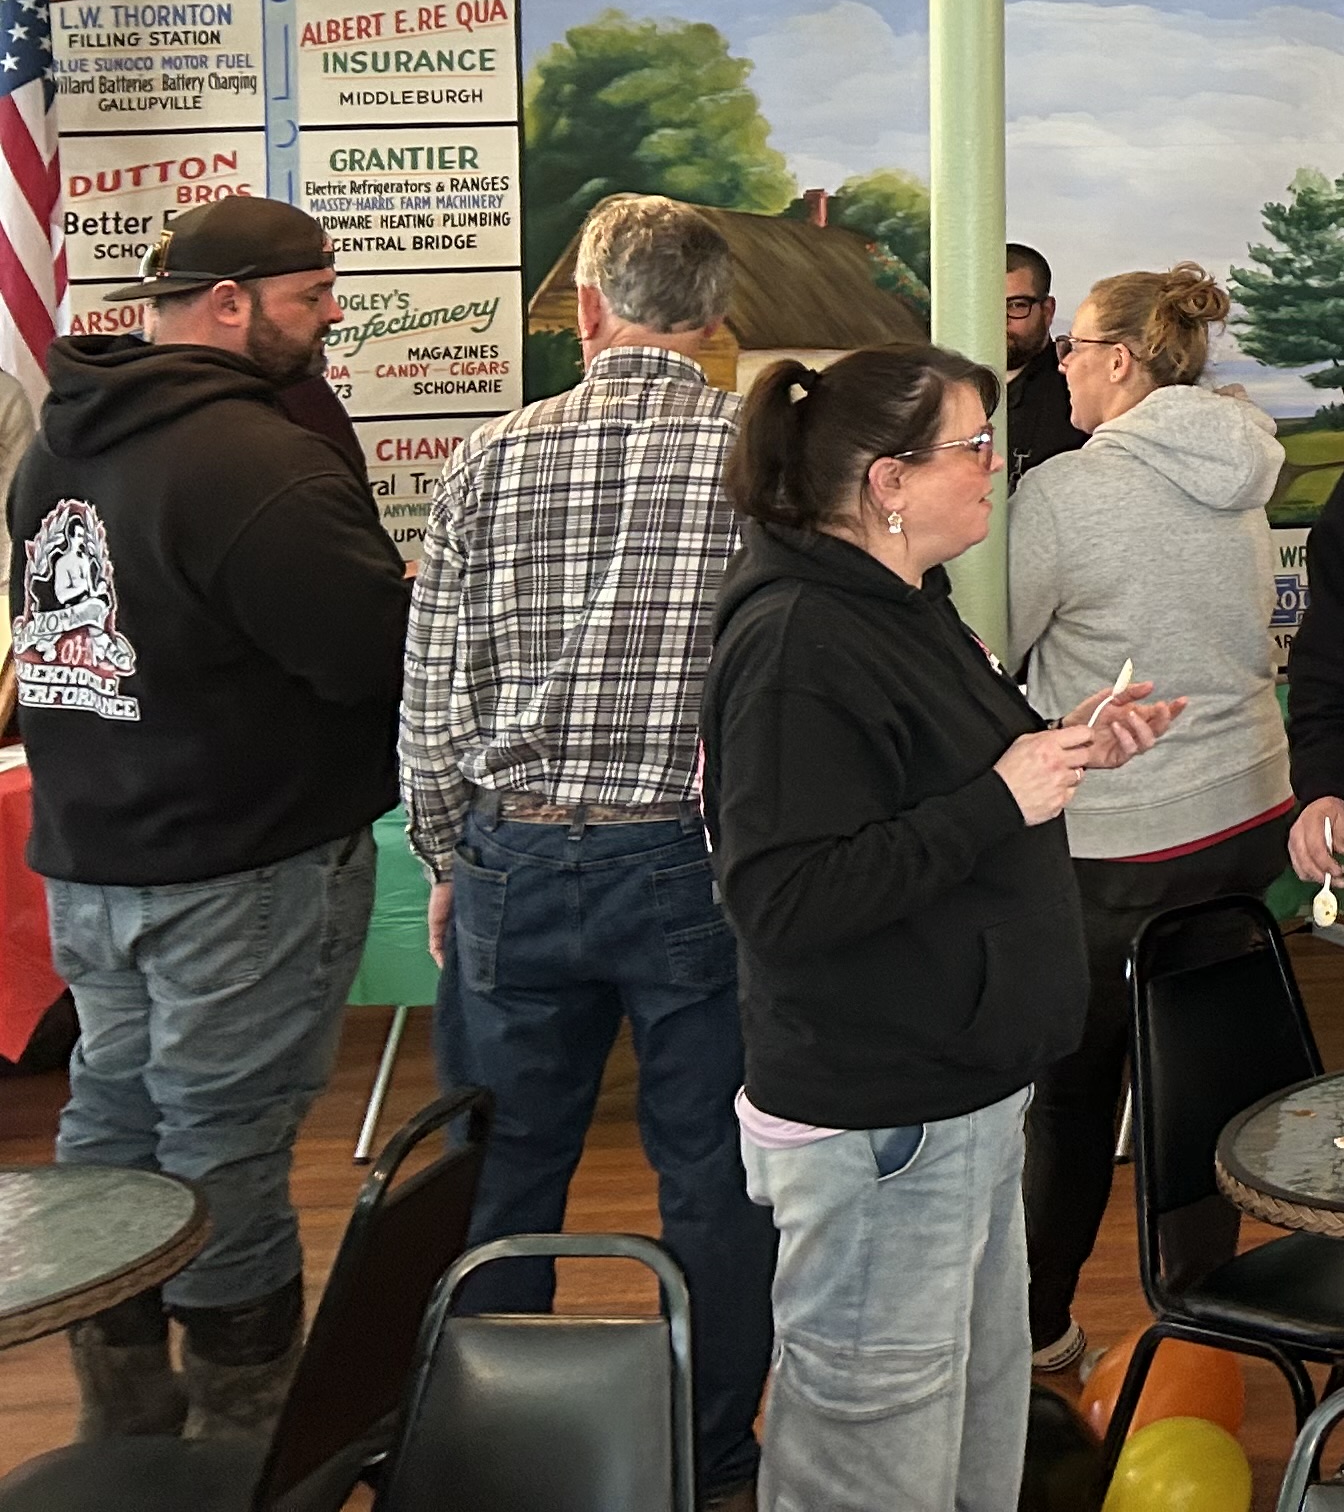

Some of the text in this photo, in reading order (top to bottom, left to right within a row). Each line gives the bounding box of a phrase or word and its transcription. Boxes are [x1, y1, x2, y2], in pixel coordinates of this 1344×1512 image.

[111, 4, 233, 28] THORNTON
[68, 30, 221, 48] FILLING STATION
[300, 12, 386, 47] ALBERT
[95, 57, 154, 72] SUNOCO
[162, 55, 208, 70] MOTOR
[216, 53, 255, 68] FUEL
[322, 49, 497, 74] INSURANCE
[53, 70, 257, 95] illard Batteries Battery Charging
[99, 95, 202, 112] GALLUPVILLE
[339, 88, 483, 106] MIDDLEBURGH
[329, 146, 478, 172] GRANTIER
[69, 150, 238, 197] DUTTON
[305, 176, 510, 197] Electric Refrigerators & RANGES
[310, 194, 504, 212] MASSEY-HARRIS FARM MACHINERY
[64, 210, 153, 235] Better
[380, 214, 435, 228] HEATING
[442, 212, 511, 227] PLUMBING
[333, 235, 478, 252] CENTRAL BRIDGE
[323, 296, 501, 358] onfectionery
[408, 345, 499, 361] MAGAZINES
[375, 364, 432, 379] CANDY
[450, 361, 510, 376] CIGARS
[413, 380, 503, 395] SCHOHARIE
